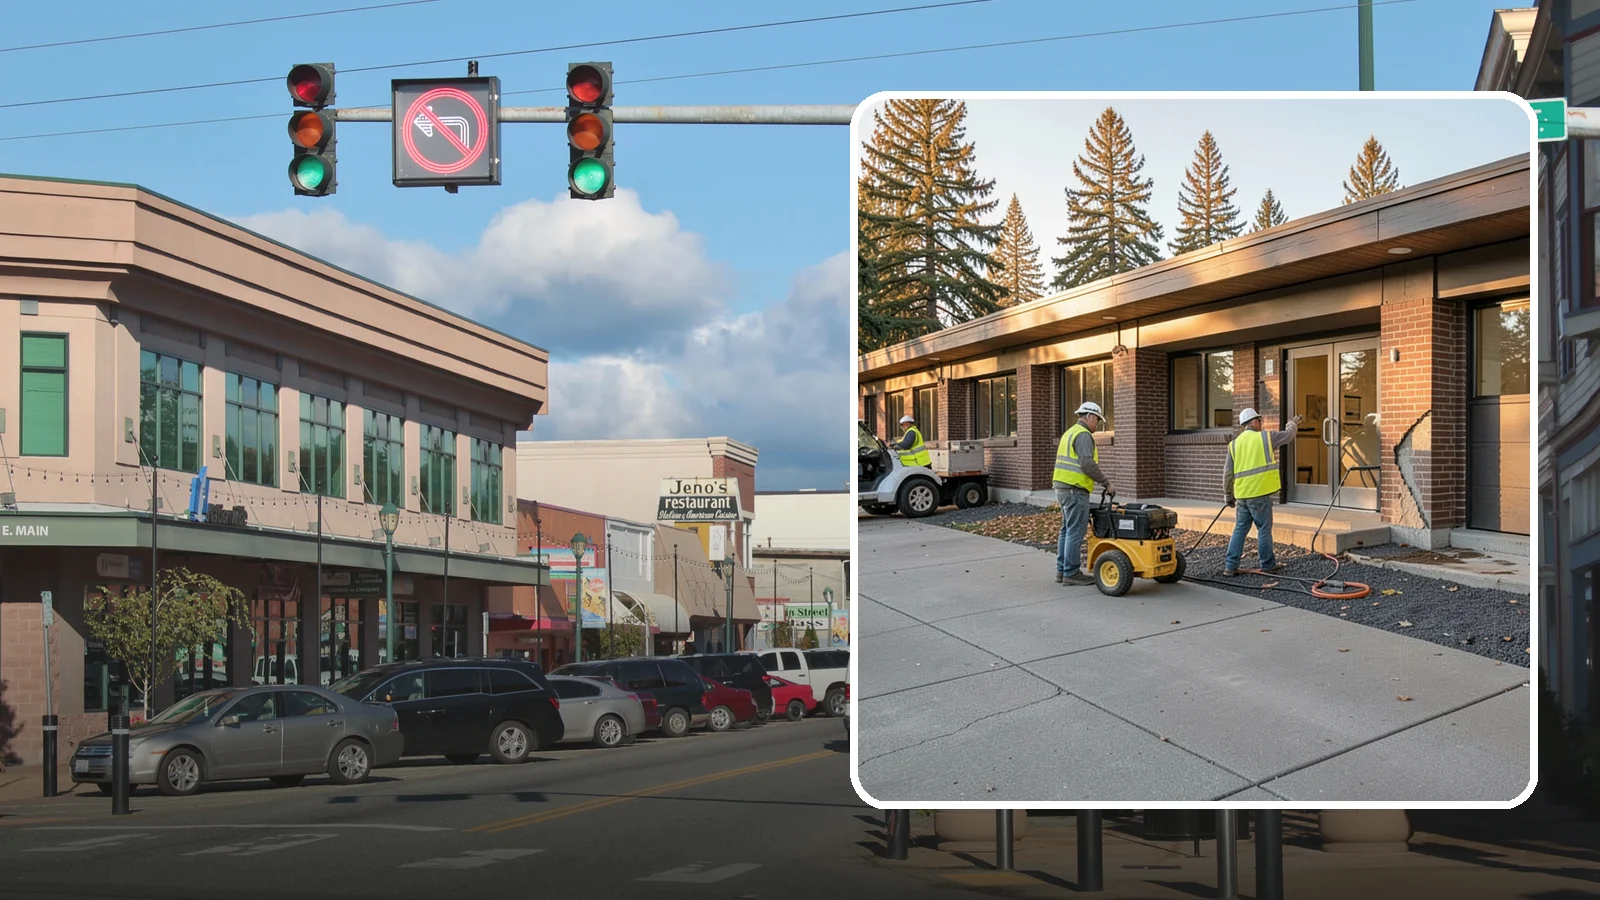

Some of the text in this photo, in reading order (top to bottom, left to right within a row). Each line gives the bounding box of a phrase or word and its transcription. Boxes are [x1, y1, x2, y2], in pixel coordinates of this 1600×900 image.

[669, 480, 728, 494] Jeno's
[665, 496, 731, 509] restaurant
[659, 510, 681, 519] Italian
[686, 510, 714, 519] American
[715, 510, 738, 519] Cuisine
[2, 525, 49, 536] E. MAIN
[785, 606, 794, 616] in
[797, 607, 828, 616] Street
